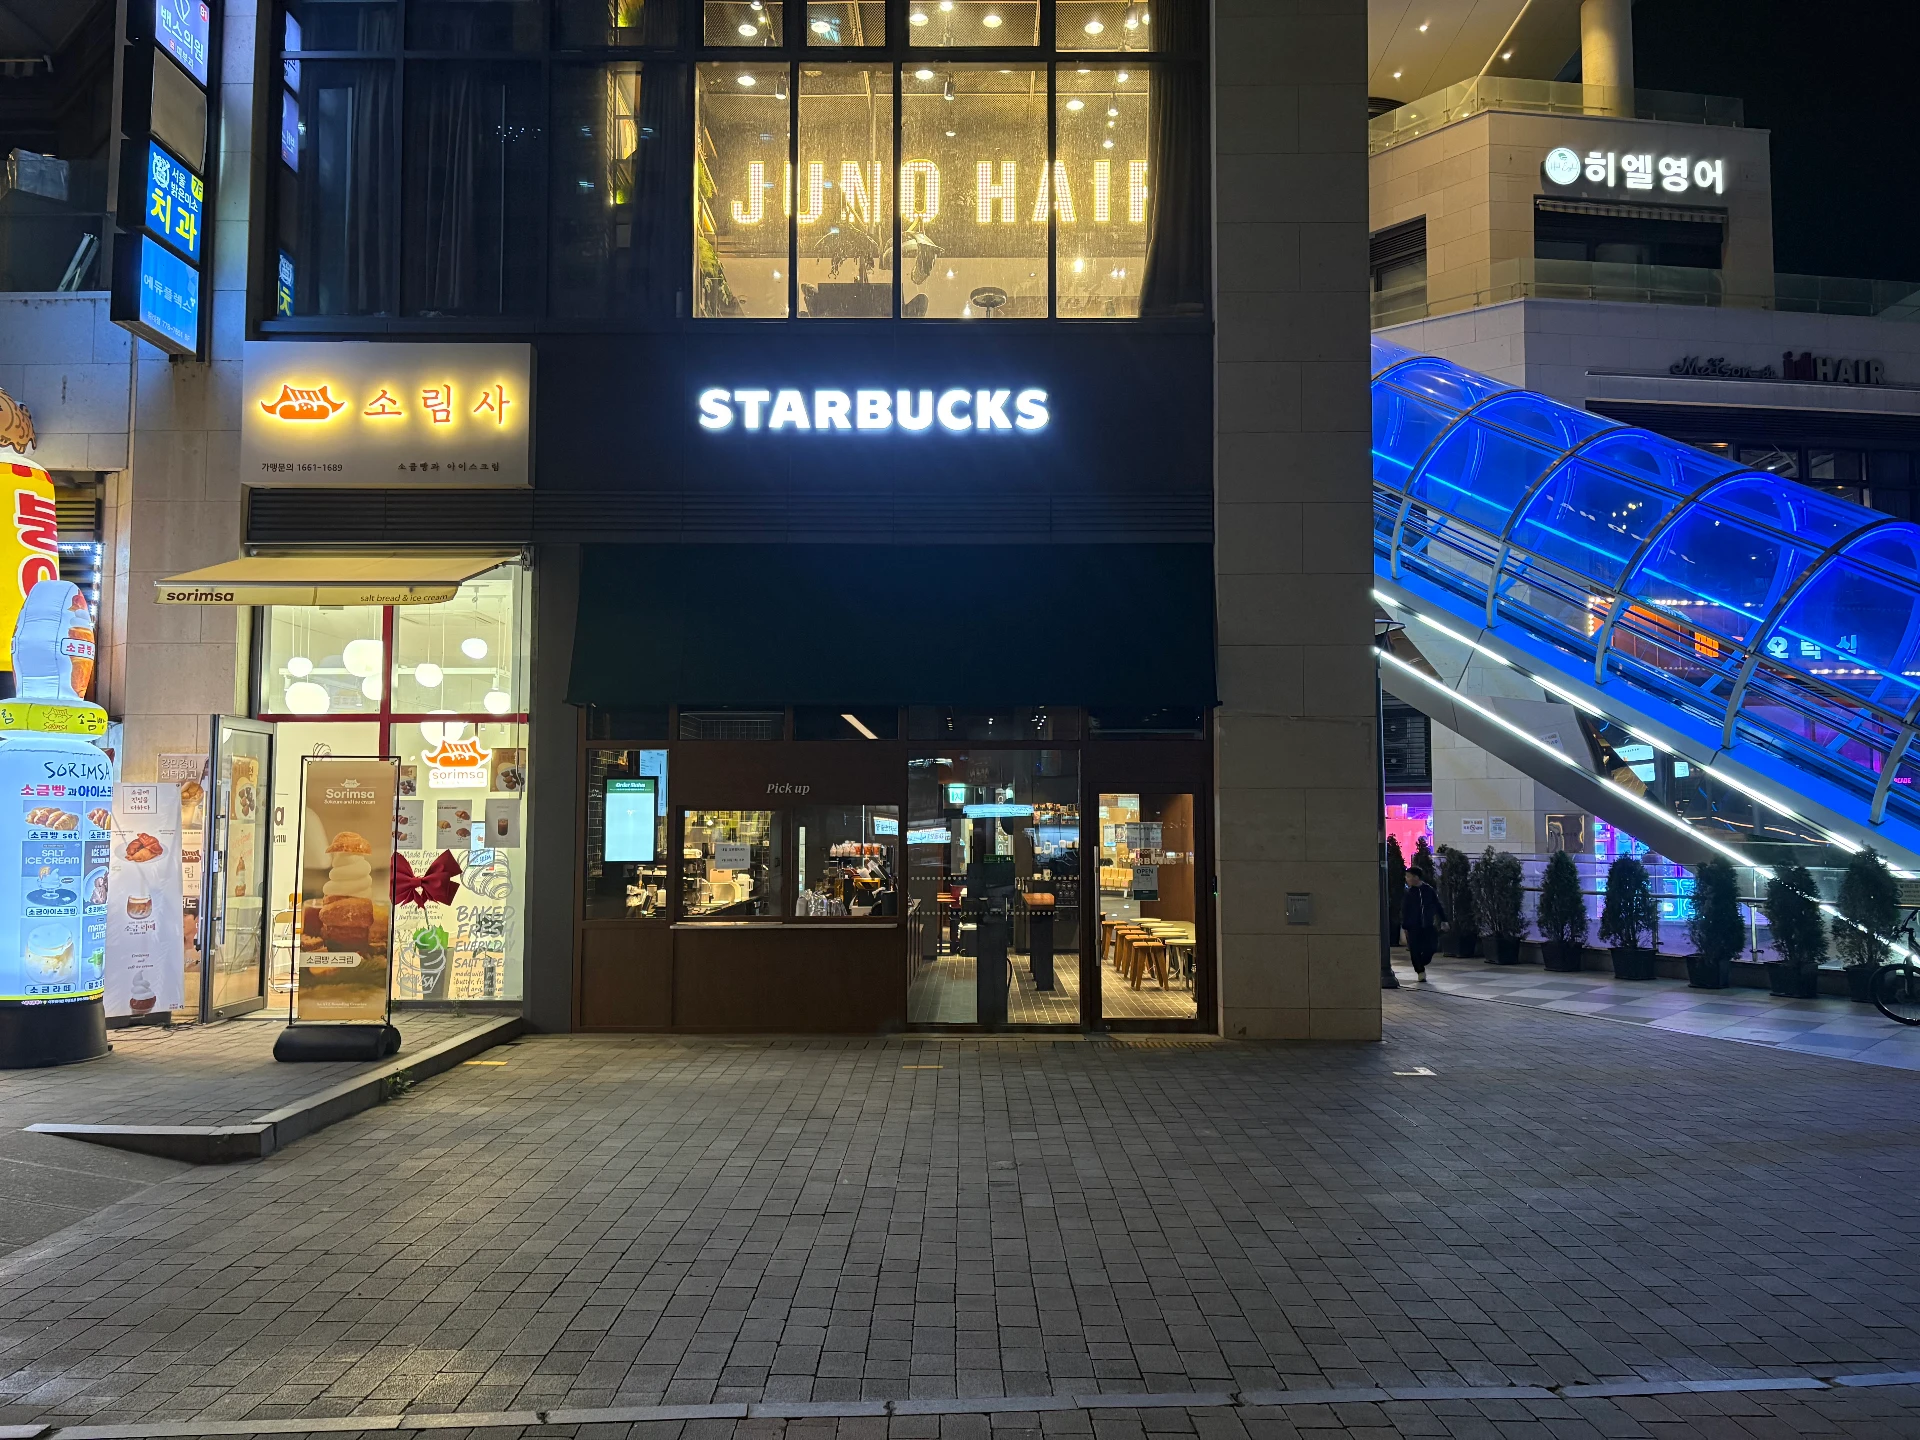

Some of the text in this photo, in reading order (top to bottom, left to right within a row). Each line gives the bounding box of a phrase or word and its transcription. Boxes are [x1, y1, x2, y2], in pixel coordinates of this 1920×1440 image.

[161, 5, 203, 65] 밴스의원
[172, 167, 186, 189] 서울
[1585, 151, 1723, 195] 히엘영어
[194, 178, 203, 196] 7F
[730, 159, 940, 225] JUNO
[171, 181, 199, 213] 밝은미소
[151, 187, 198, 251] 치과
[144, 274, 192, 314] 에듀플렉스
[1814, 357, 1887, 384] HAIR
[364, 384, 511, 425] 소림사
[698, 388, 1051, 431] STARBUCKS
[261, 462, 344, 473] 가맹문의 1661-1689
[446, 461, 501, 473] 아이스크림
[166, 588, 235, 603] sorimsa
[360, 594, 375, 602] salt
[375, 594, 401, 602] bread
[409, 594, 422, 602] ice
[423, 593, 448, 602] cream
[43, 761, 112, 781] SORIMSA
[431, 769, 485, 780] sorimsa
[325, 788, 375, 799] Sorimsa
[766, 782, 811, 797] Pick up
[25, 856, 80, 865] ICE CREAM
[41, 849, 66, 857] SALT
[456, 905, 516, 922] BAKED
[456, 921, 515, 939] FRESH
[454, 957, 480, 968] SALT
